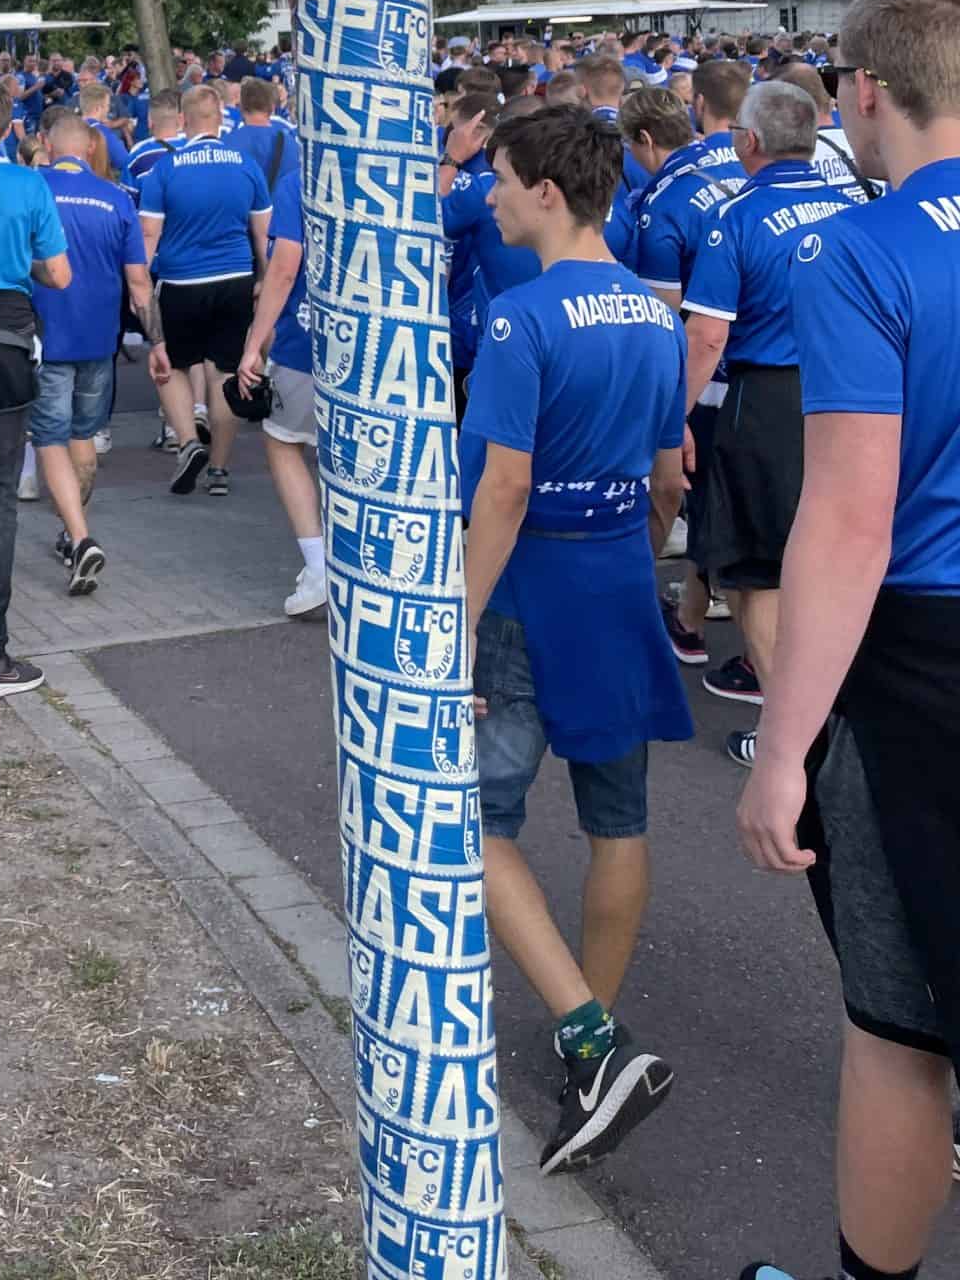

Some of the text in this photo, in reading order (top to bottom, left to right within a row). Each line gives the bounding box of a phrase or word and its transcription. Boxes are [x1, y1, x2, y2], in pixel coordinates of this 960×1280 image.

[762, 207, 796, 236] 1.FC
[561, 293, 675, 331] MAGDEBURG
[367, 513, 425, 544] 1.FC
[403, 606, 455, 634] 1.FC
[339, 758, 464, 875] ASP
[359, 864, 486, 969] ASP
[382, 1132, 441, 1174] 1.FC
[415, 1230, 476, 1261] 1.FC
